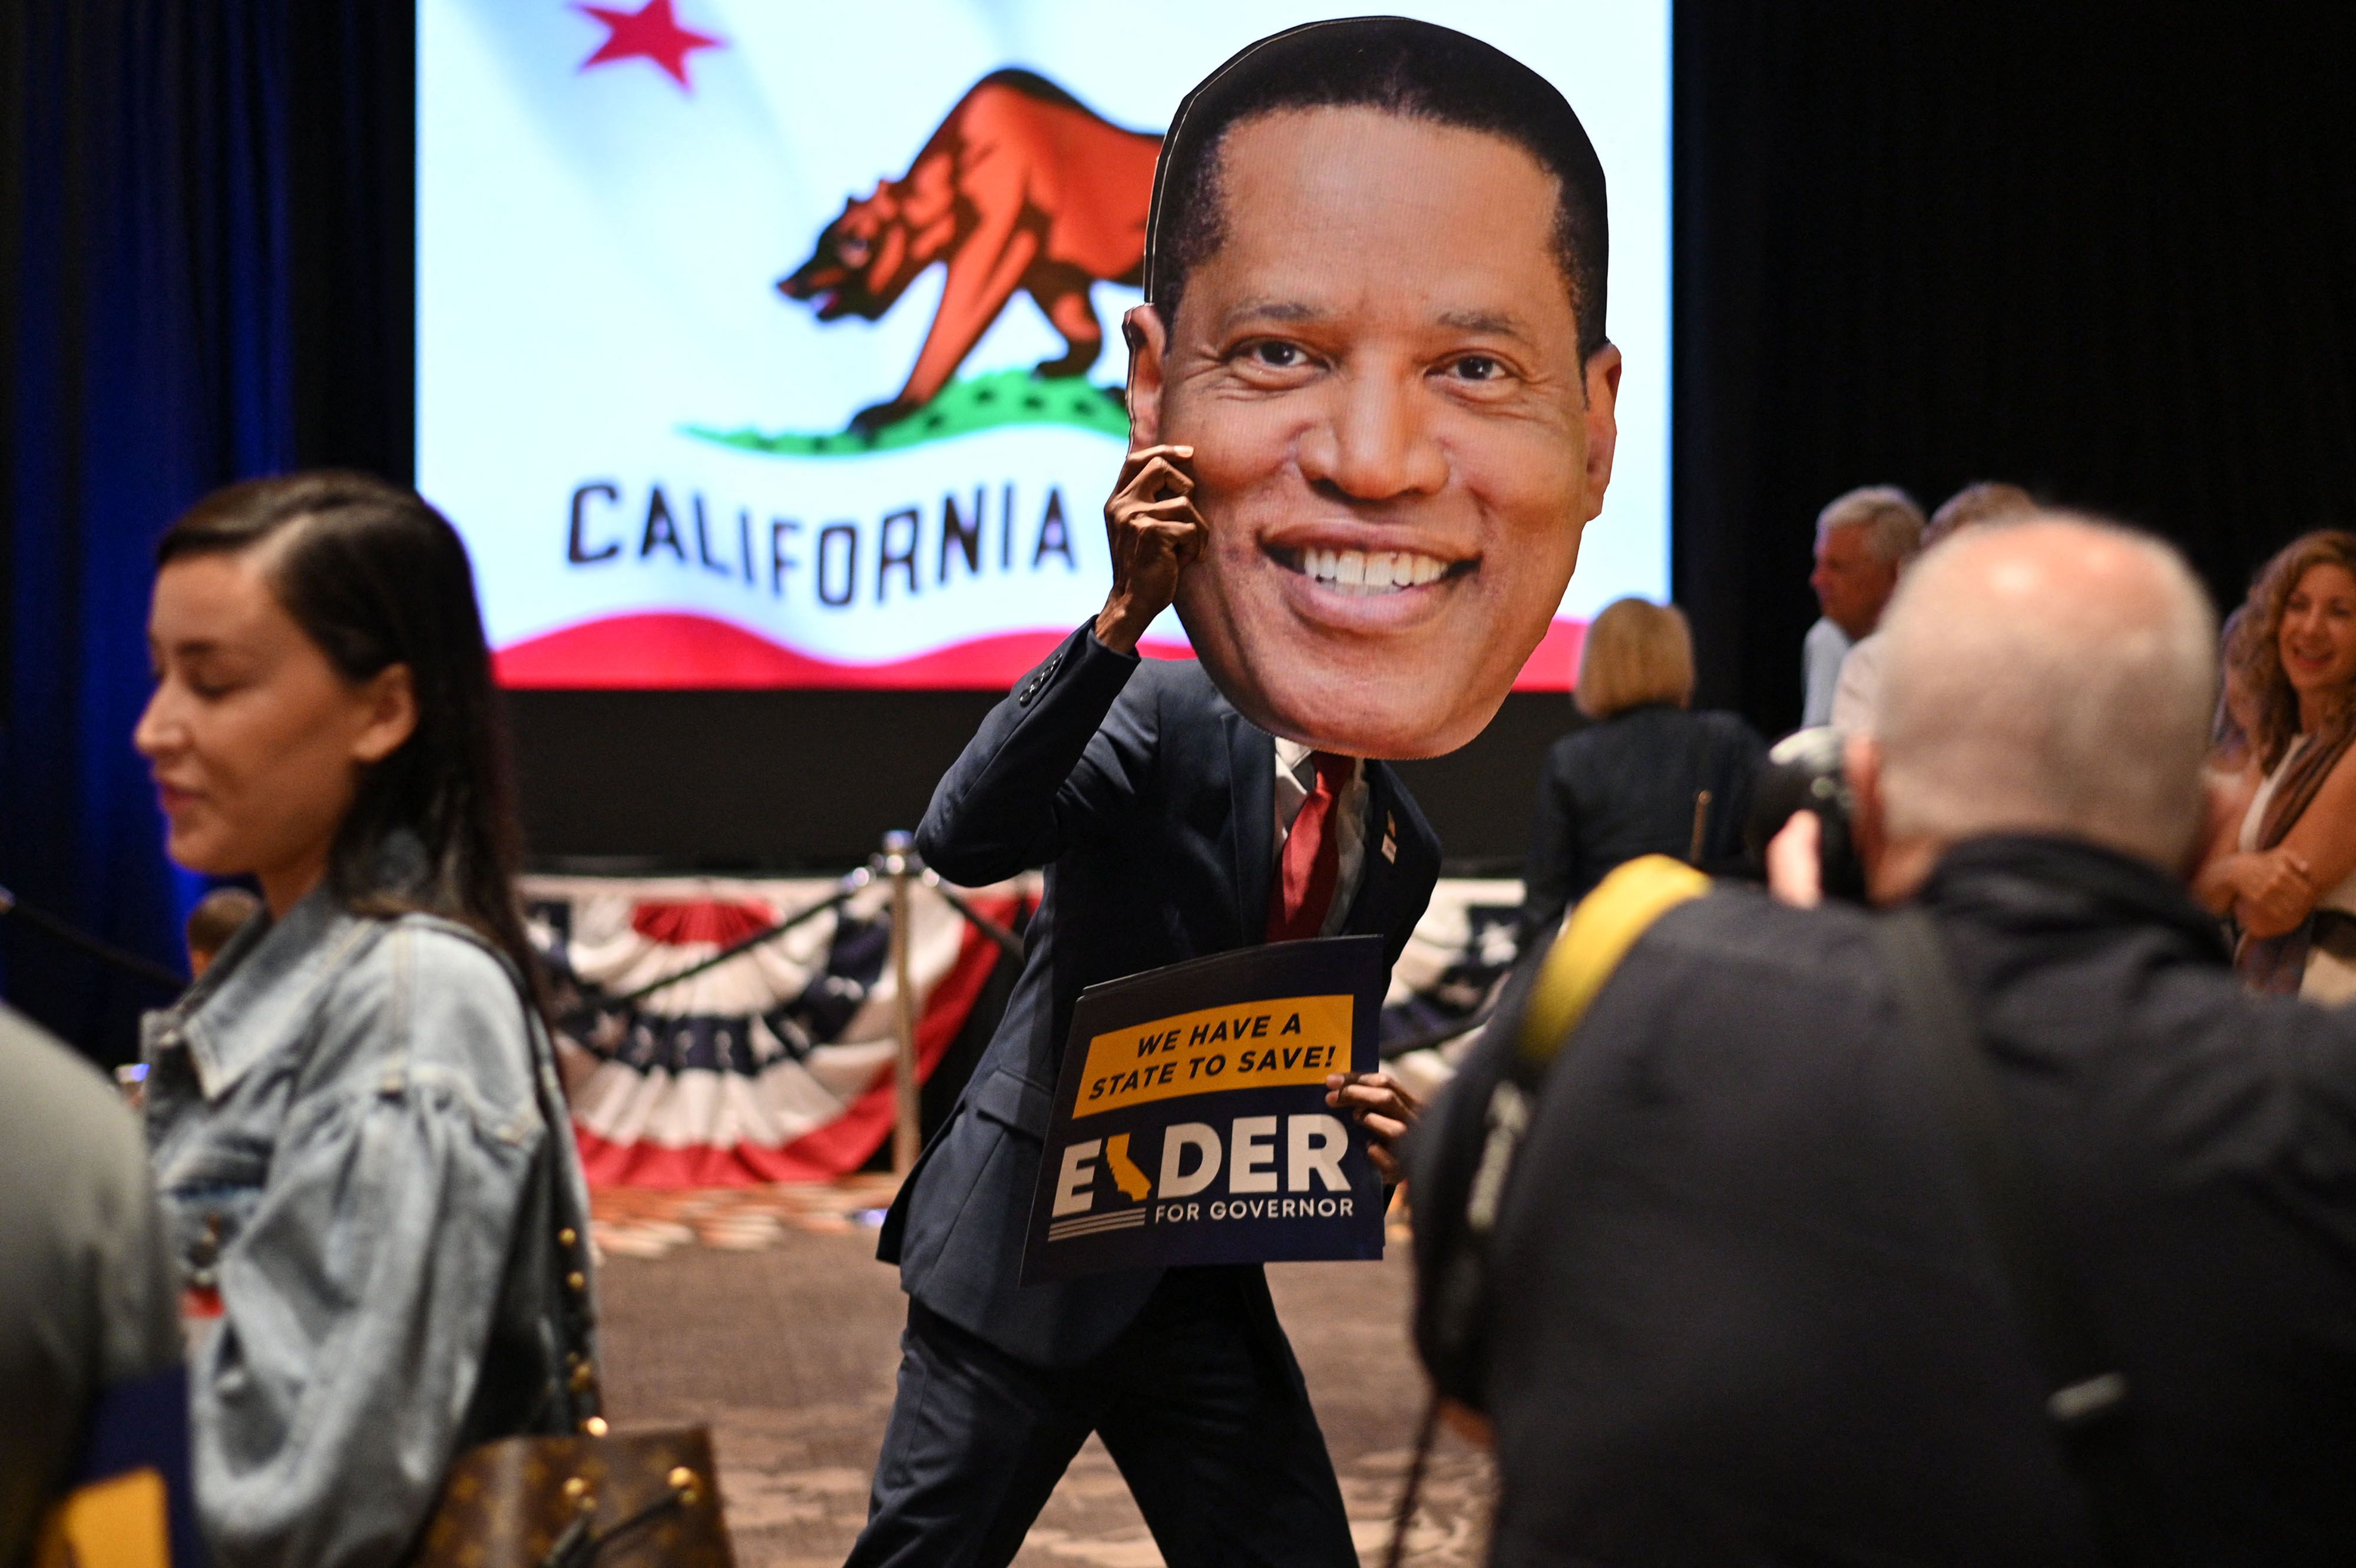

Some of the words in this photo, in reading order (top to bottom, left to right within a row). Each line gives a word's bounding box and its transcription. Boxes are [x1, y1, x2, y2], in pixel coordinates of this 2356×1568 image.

[568, 483, 1077, 606] CALIFORNIA
[1137, 1030, 1180, 1058] WE
[1188, 1015, 1270, 1046] HAVE
[1280, 1013, 1301, 1034] A
[1089, 1063, 1177, 1100] STATE
[1188, 1054, 1225, 1080] TO
[1237, 1046, 1336, 1073] SAVE!
[1155, 1204, 1199, 1224] FOR
[1210, 1198, 1354, 1220] GOVERNOR
